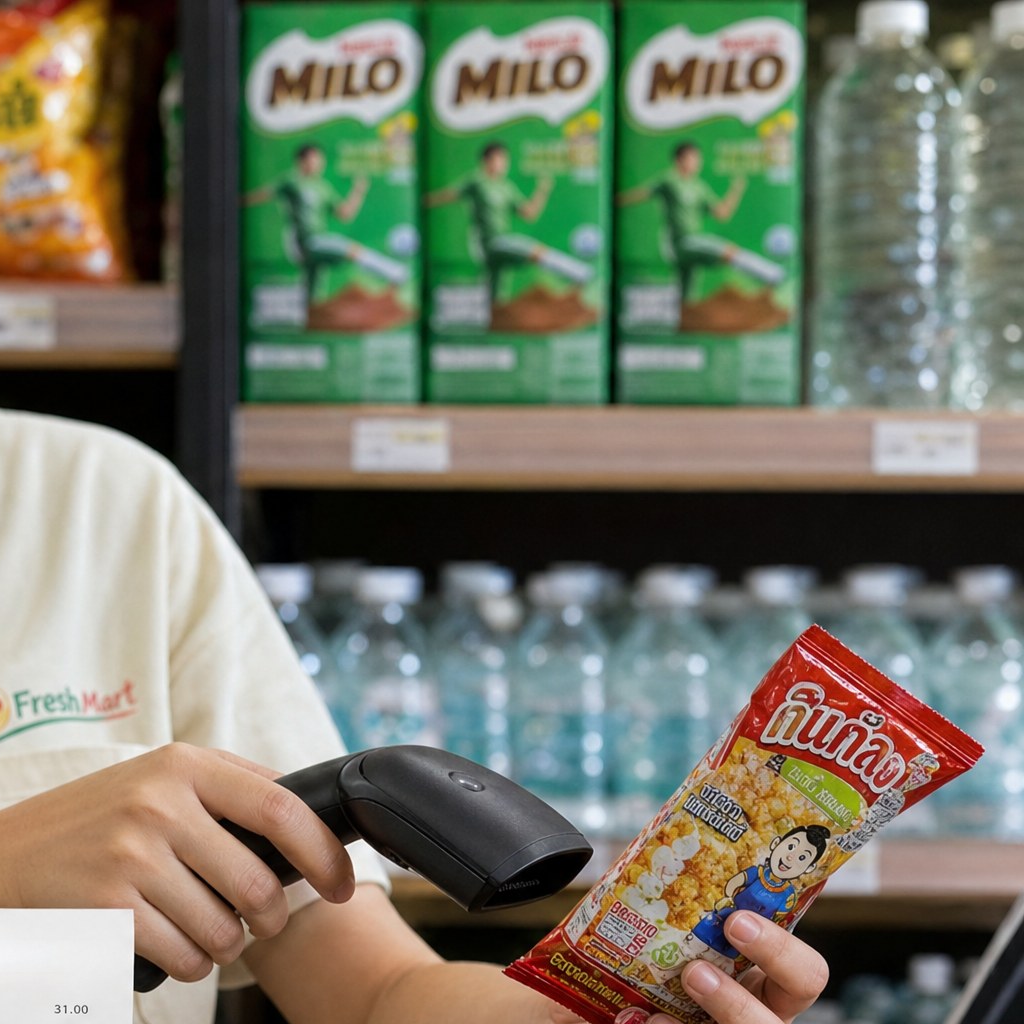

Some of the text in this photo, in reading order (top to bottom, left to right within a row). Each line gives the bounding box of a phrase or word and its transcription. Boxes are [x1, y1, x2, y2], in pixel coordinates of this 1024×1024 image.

[268, 56, 403, 108] MILO
[453, 53, 588, 108] MILO
[647, 53, 785, 104] MILO
[54, 1004, 88, 1015] 31.00
